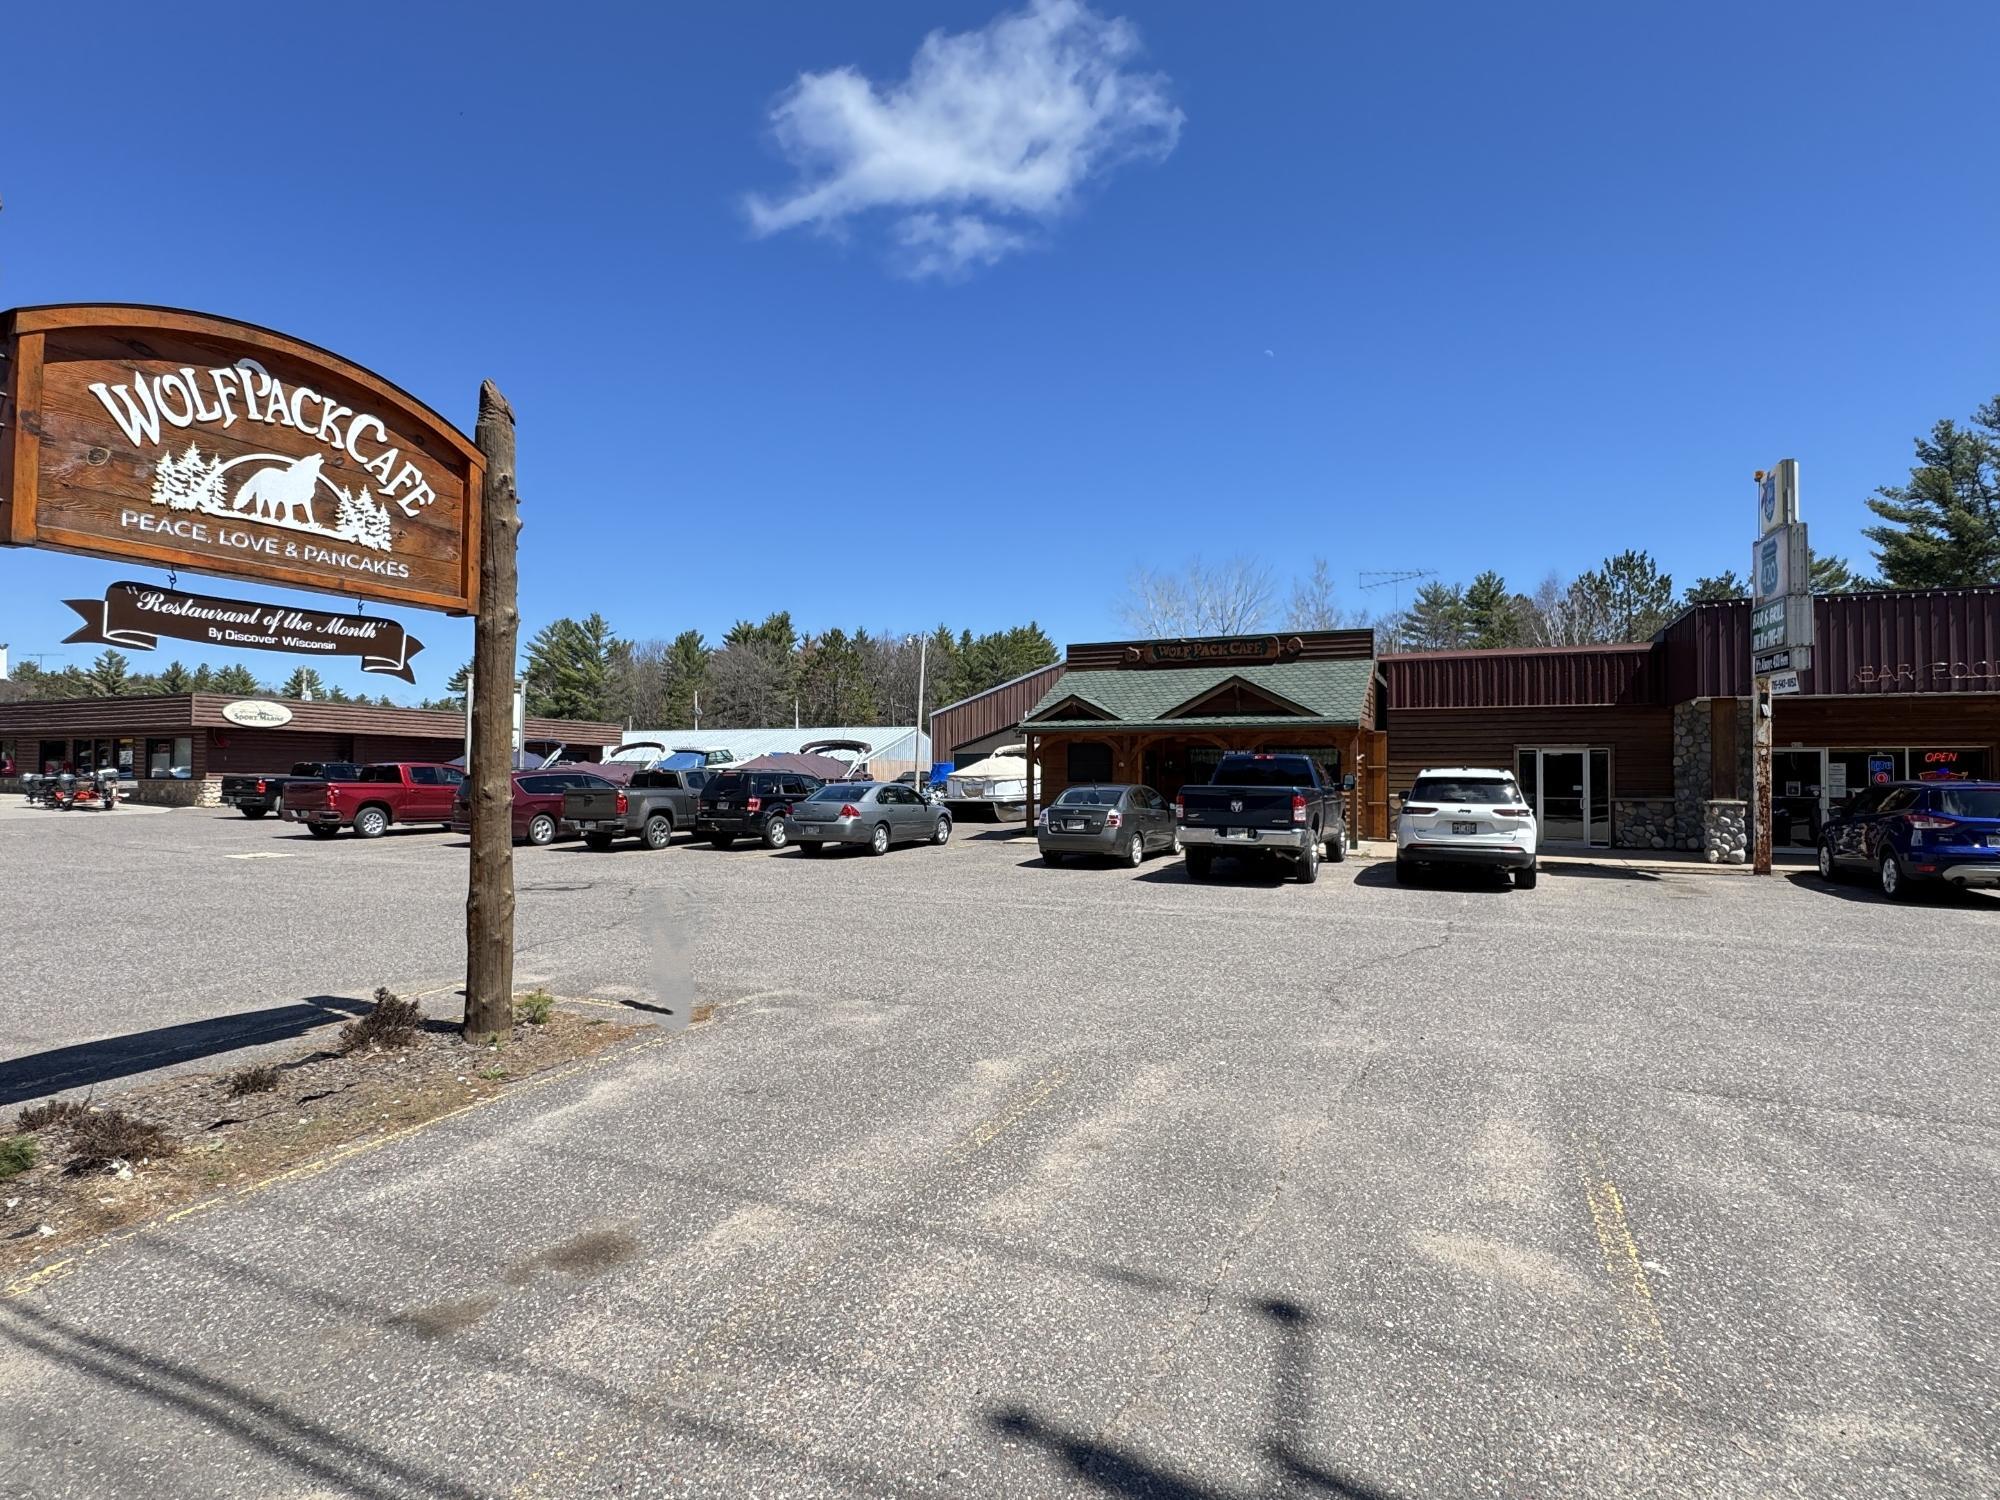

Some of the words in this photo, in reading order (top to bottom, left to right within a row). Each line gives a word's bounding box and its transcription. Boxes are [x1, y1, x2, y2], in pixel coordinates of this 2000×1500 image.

[346, 413, 436, 518] CAFE
[121, 509, 212, 544] PEACE,
[219, 528, 280, 555] LOVE
[284, 541, 299, 558] &
[304, 545, 410, 578] PANCAKES
[263, 610, 285, 634] of
[284, 612, 312, 631] the
[208, 627, 222, 641] By
[226, 630, 279, 645] Discover
[282, 637, 337, 651] Wisconsin
[1158, 644, 1192, 658] WOLF
[1194, 642, 1226, 657] PACK
[1229, 641, 1262, 655] CAFE
[1859, 664, 1914, 682] BAR
[1924, 752, 1958, 763] OPEN
